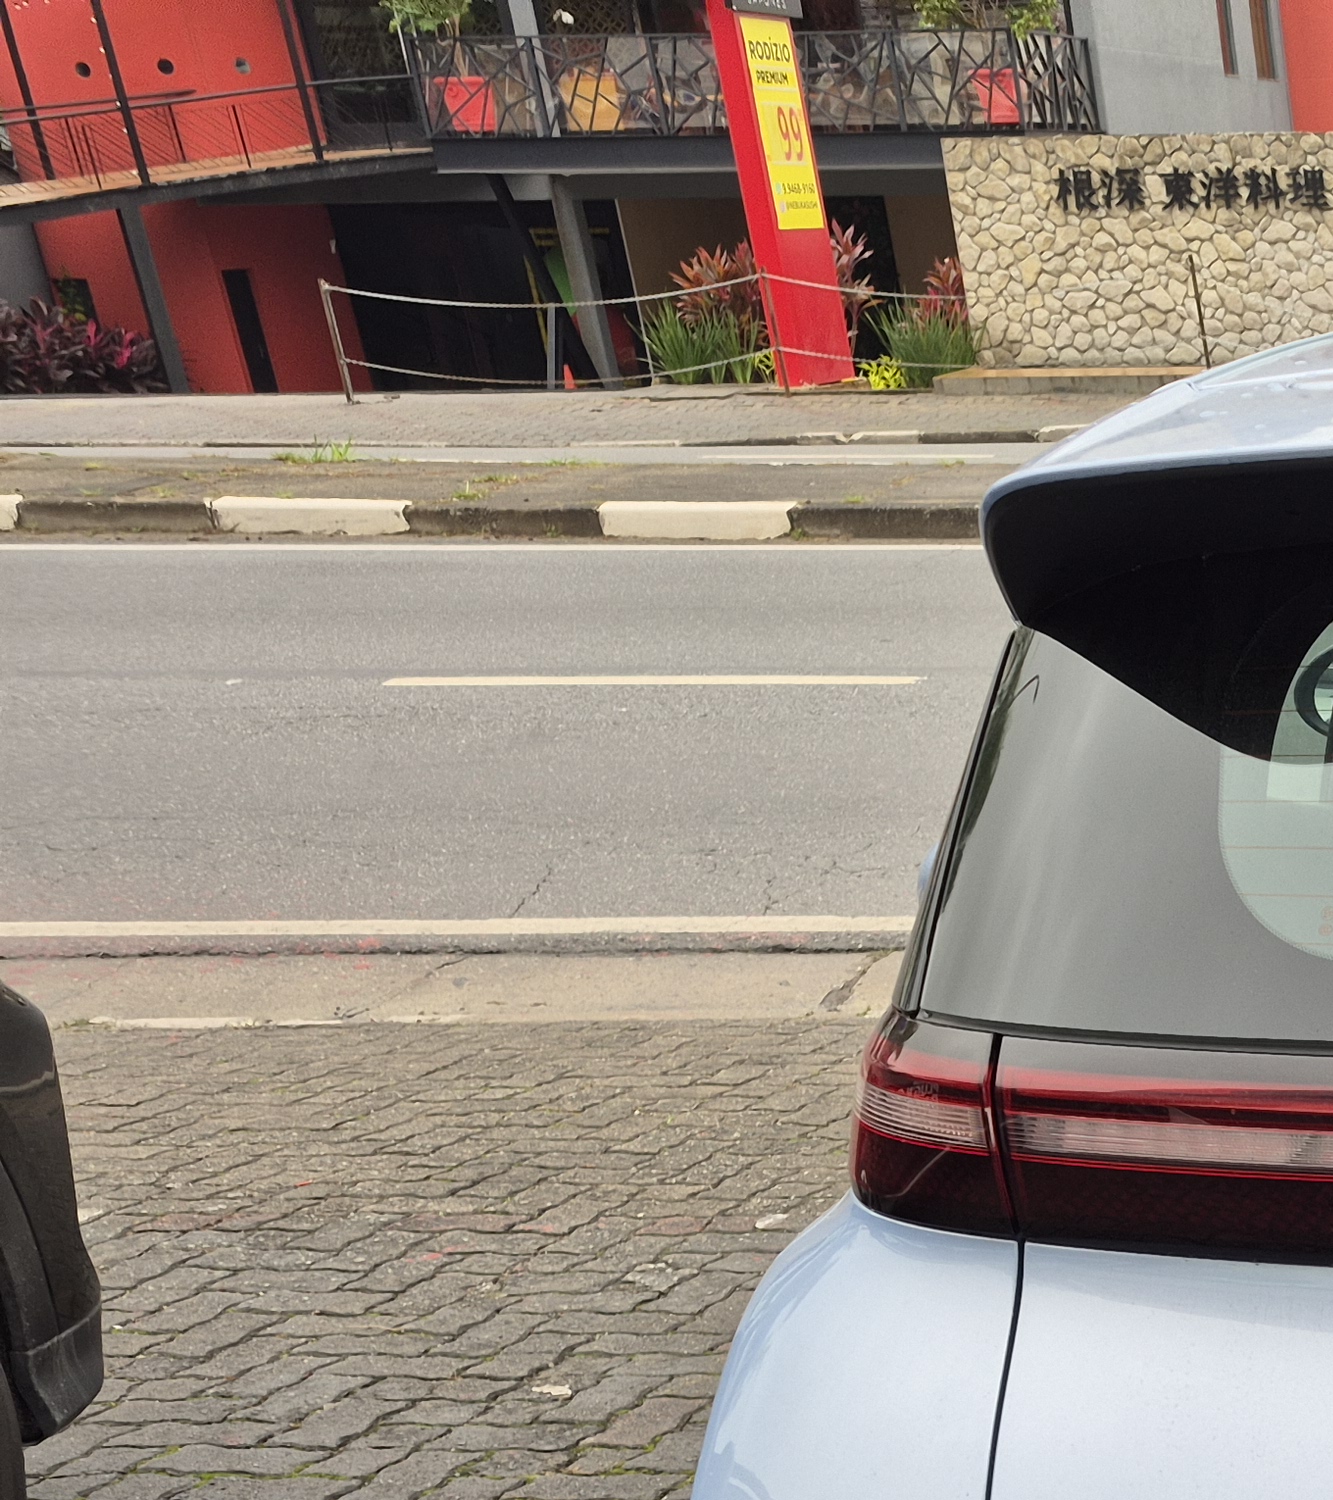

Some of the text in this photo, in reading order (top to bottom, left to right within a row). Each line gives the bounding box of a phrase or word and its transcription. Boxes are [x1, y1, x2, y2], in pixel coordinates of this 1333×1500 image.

[748, 37, 791, 63] RODÍZIO
[756, 70, 789, 85] PREMIUM
[777, 106, 803, 161] 99
